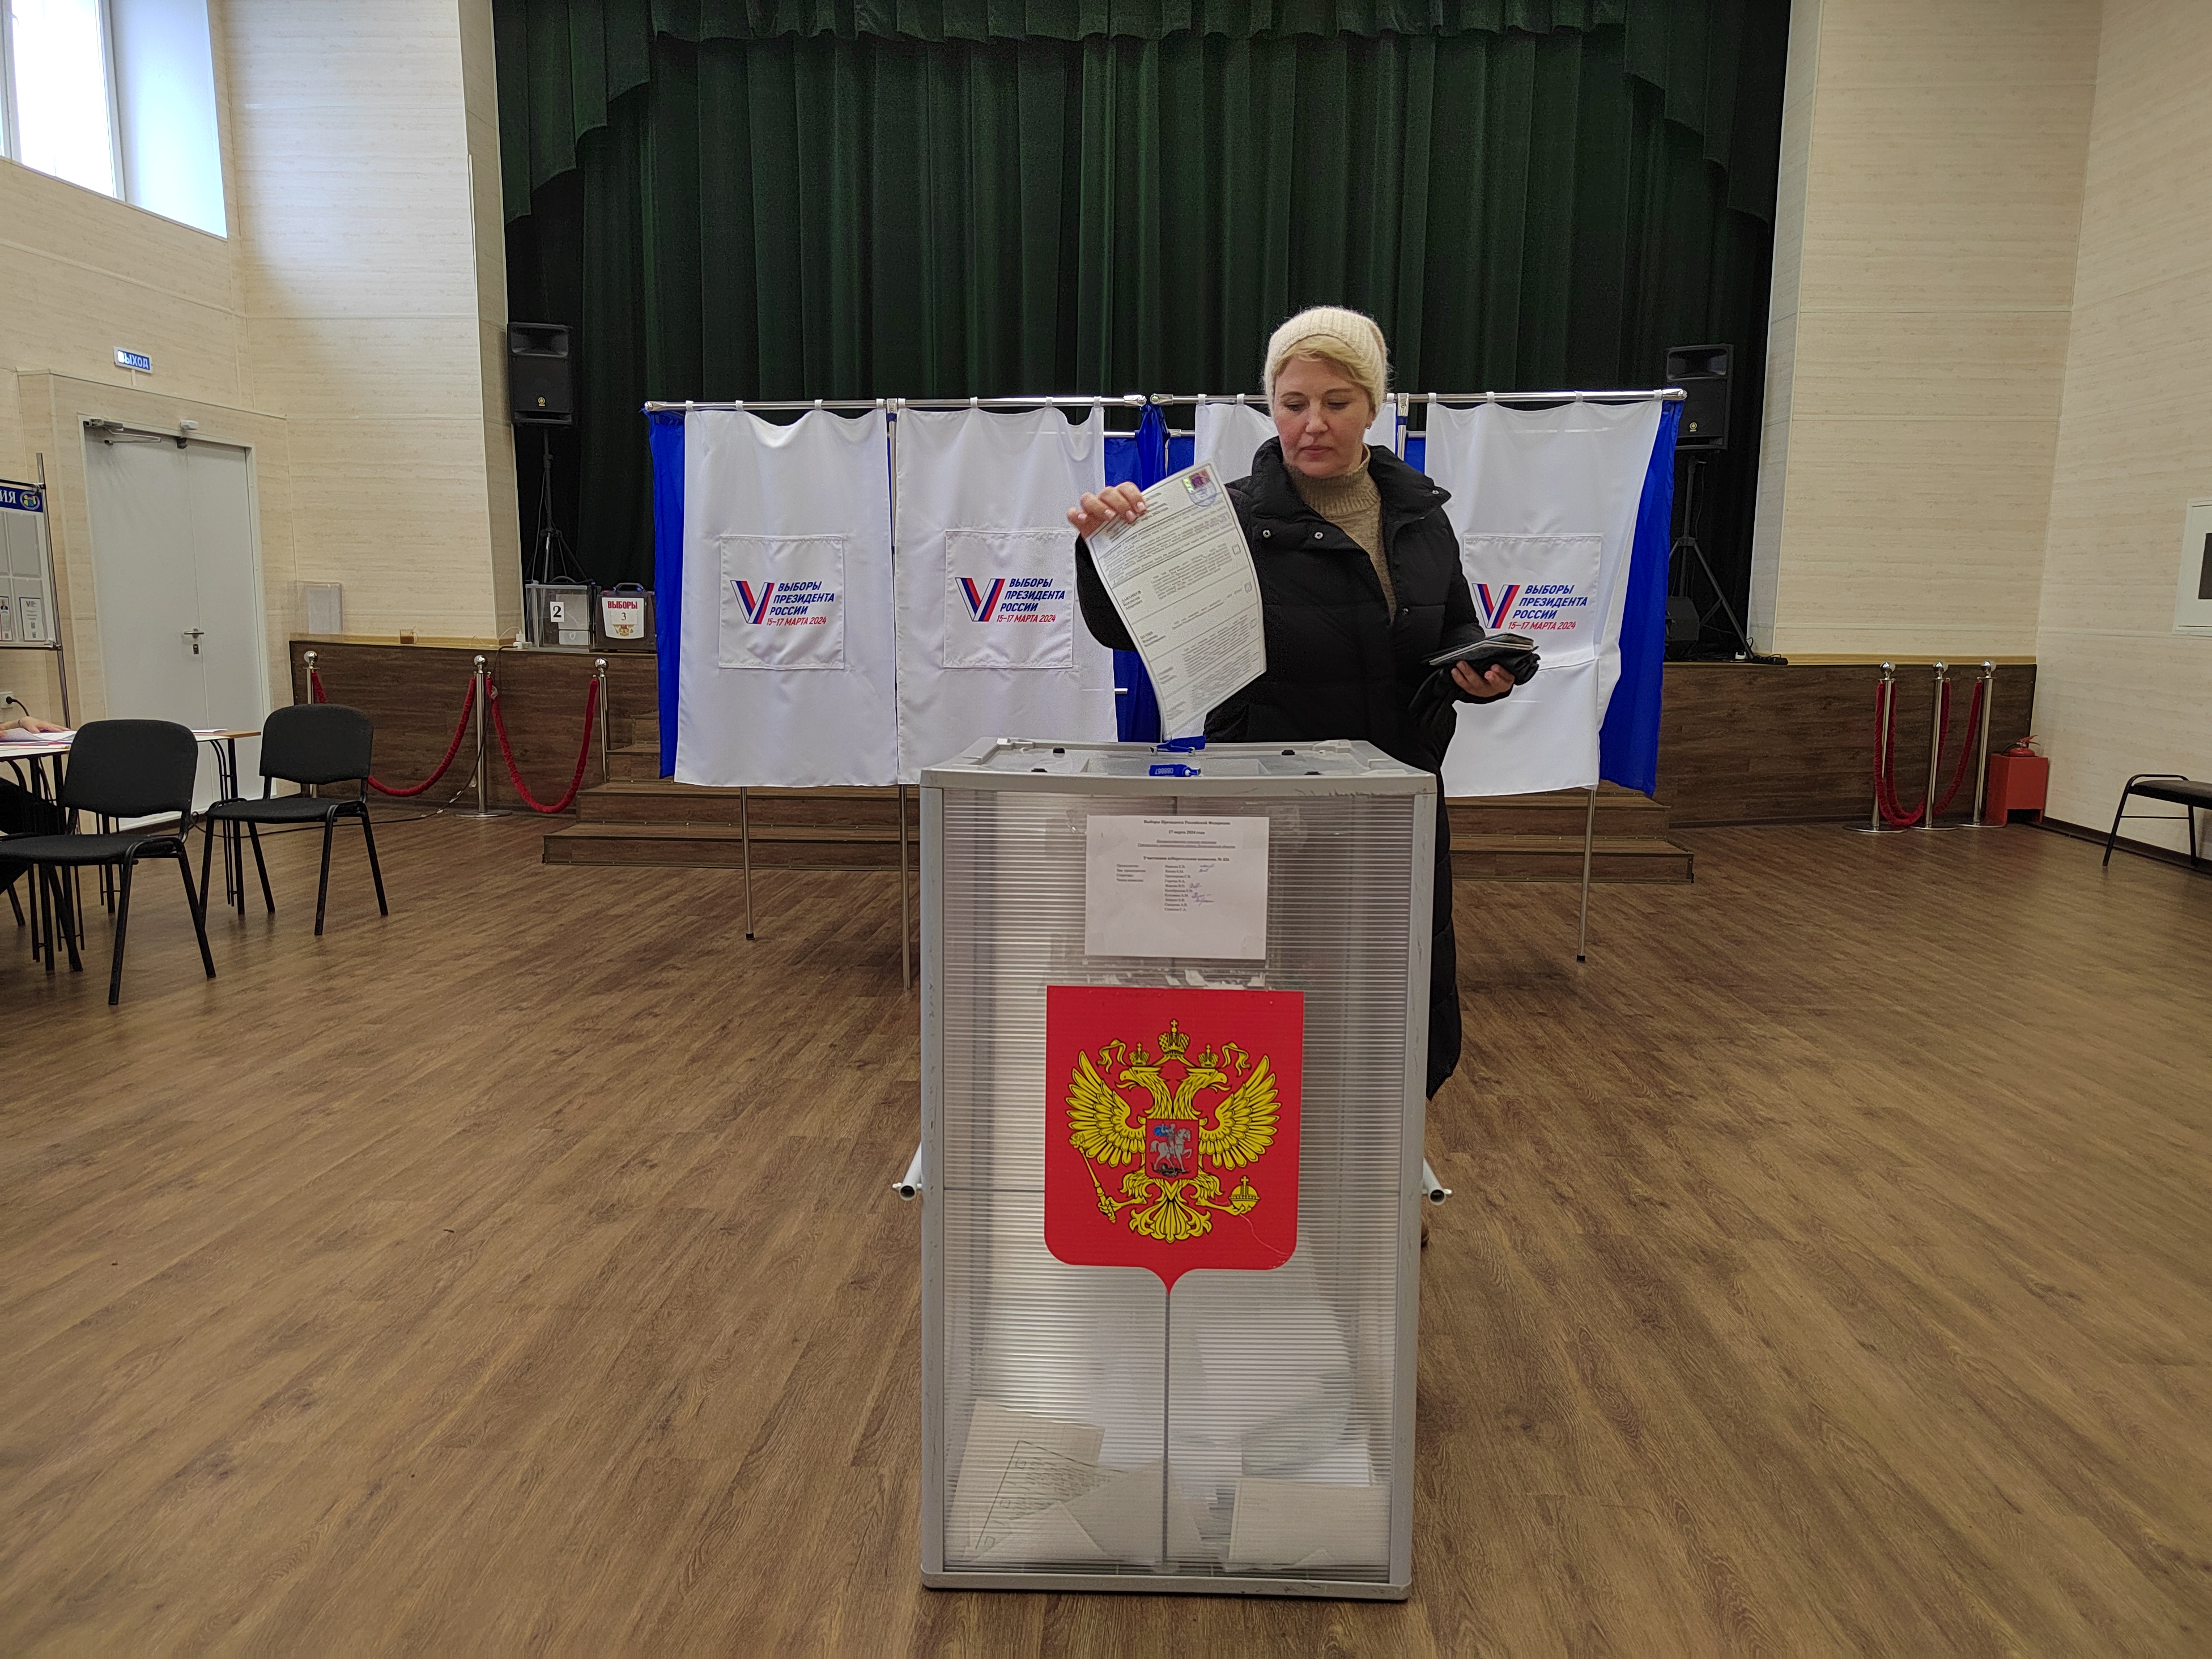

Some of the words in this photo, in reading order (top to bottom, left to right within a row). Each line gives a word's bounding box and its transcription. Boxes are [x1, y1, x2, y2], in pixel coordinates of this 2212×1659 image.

[117, 351, 149, 369] ЫХОД
[777, 581, 822, 592] ВЫБОРЫ
[1009, 578, 1053, 588] ВЫБОРЫ
[1525, 584, 1575, 594] ВЫБОРЫ
[773, 593, 835, 604] ПРЕЗИДЕНТА
[1004, 590, 1065, 601] ПРЕЗИДЕНТА
[607, 601, 638, 609] ВЫБОРЫ
[999, 603, 1039, 612] РОССИИ
[1518, 597, 1588, 608] ПРЕЗИДЕНТА
[552, 605, 562, 618] 2
[769, 606, 809, 615] РОССИИ
[1512, 610, 1558, 619] РОССИИ
[621, 612, 627, 621] 3
[785, 617, 808, 626] МАРТА
[809, 616, 827, 625] 2024
[1014, 614, 1037, 623] МАРТА
[1039, 614, 1056, 623] 2024
[1530, 622, 1556, 630] МАРТА
[1557, 621, 1576, 629] 2024
